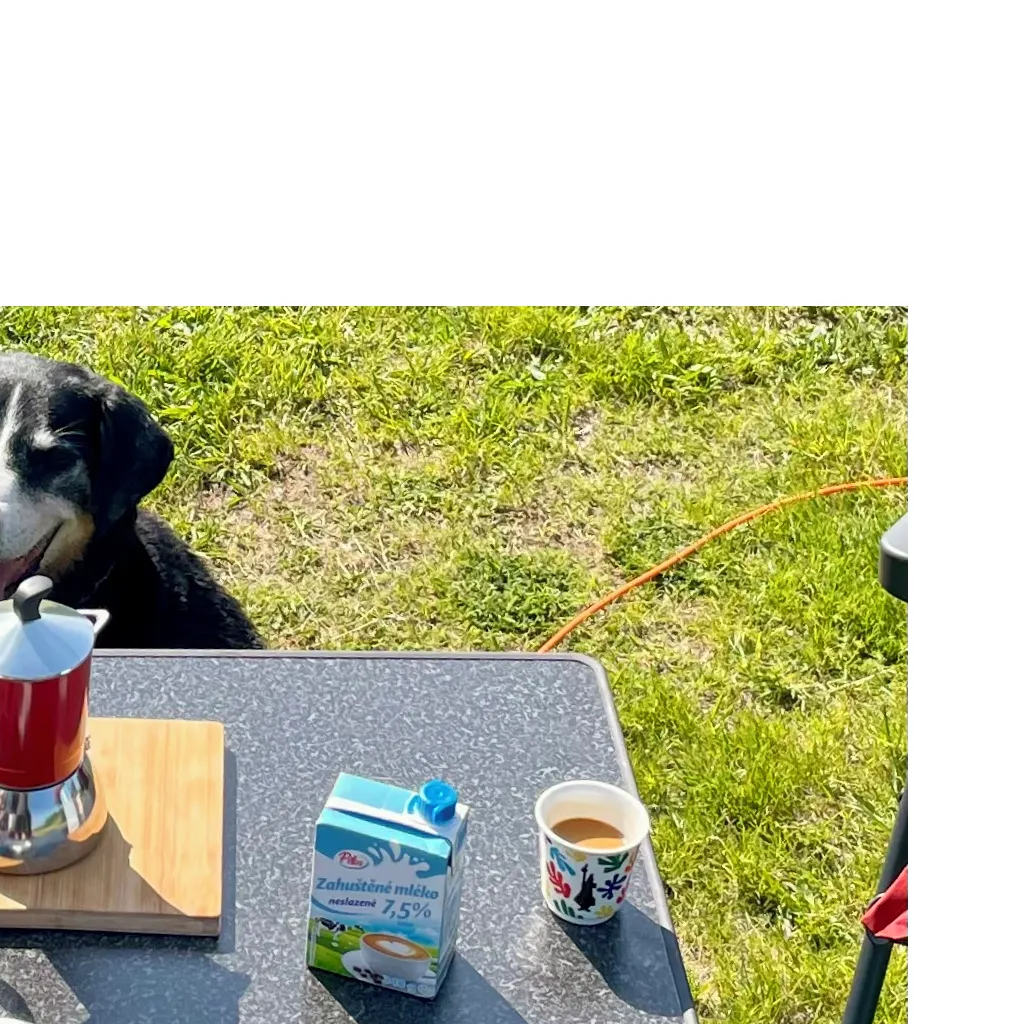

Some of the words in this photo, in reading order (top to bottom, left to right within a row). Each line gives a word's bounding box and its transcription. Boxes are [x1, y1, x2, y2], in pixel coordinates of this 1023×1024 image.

[316, 877, 393, 895] Zahuštěné
[394, 883, 439, 900] mléko
[328, 896, 377, 908] neslazené
[381, 898, 432, 920] 7,5%
